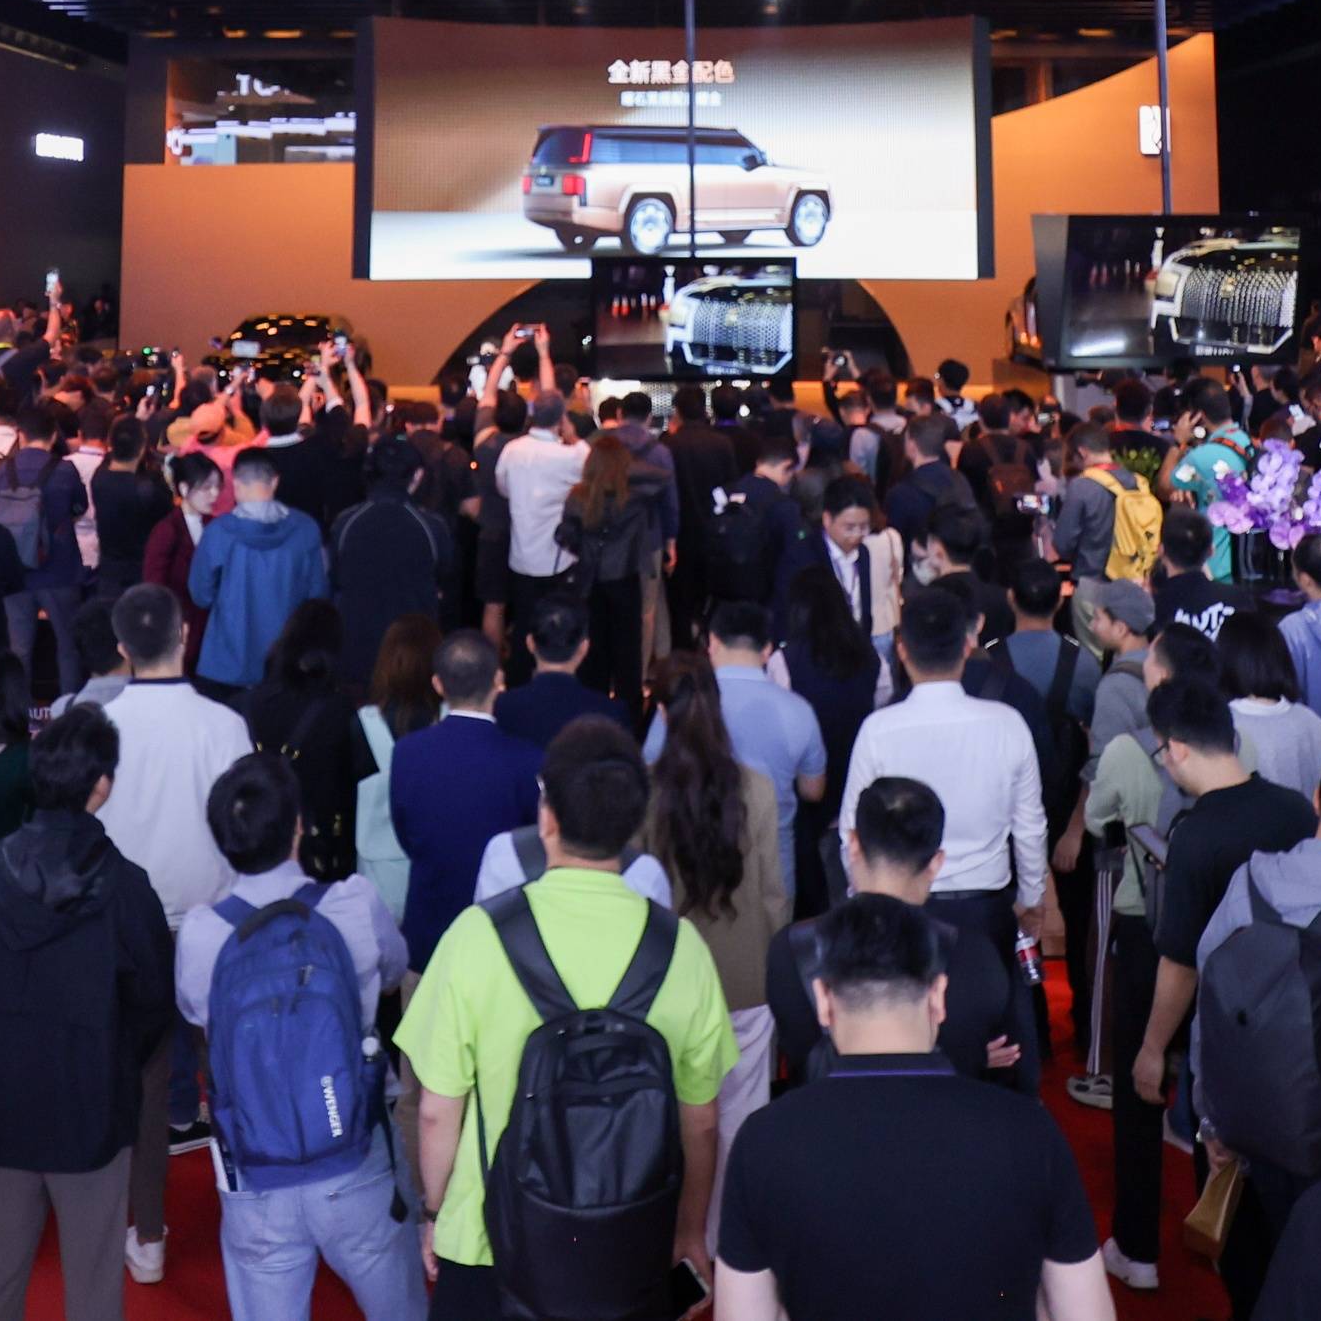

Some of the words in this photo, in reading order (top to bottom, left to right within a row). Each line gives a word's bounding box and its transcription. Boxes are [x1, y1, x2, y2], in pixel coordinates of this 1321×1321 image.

[608, 60, 734, 84] 全新黑金配色
[323, 1085, 343, 1138] WENGER
